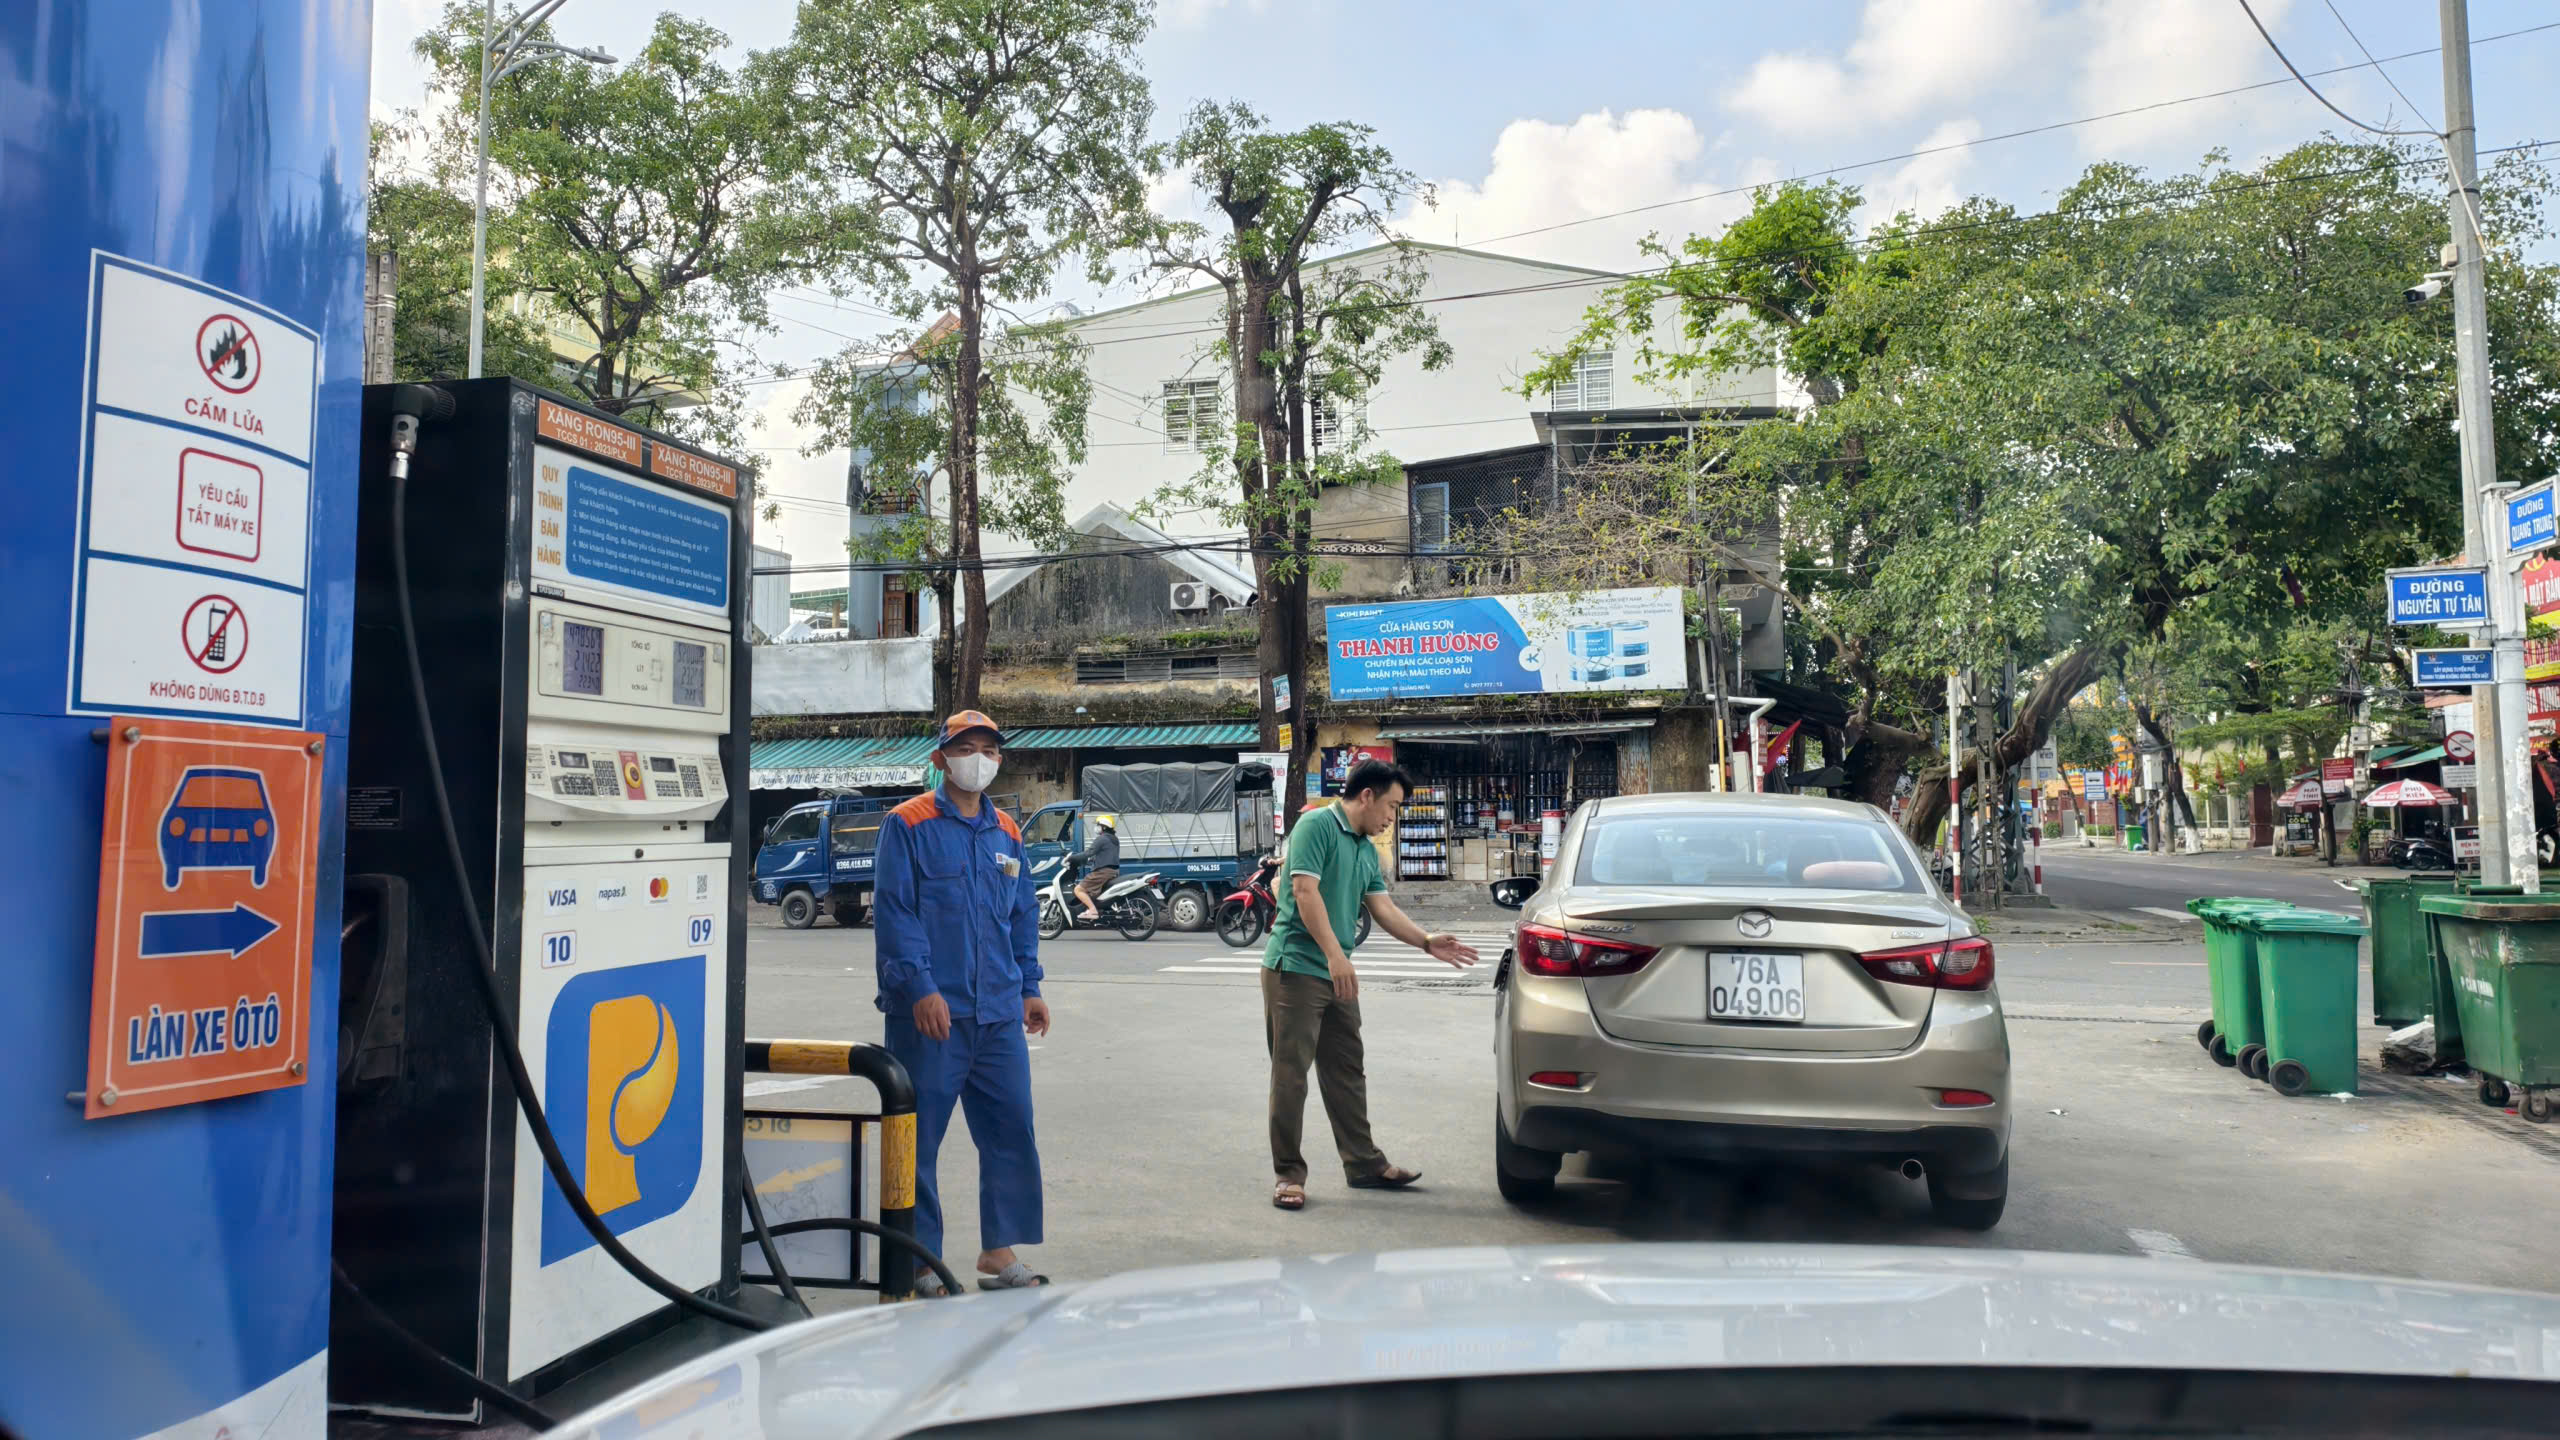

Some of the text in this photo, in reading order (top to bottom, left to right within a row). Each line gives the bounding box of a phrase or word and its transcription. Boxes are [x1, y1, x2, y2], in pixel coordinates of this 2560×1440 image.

[184, 399, 264, 437] CẤM LỬA
[547, 407, 582, 432] XĂNG
[556, 428, 577, 443] TCCS
[580, 437, 587, 448] 01
[542, 465, 559, 483] QUY
[199, 483, 248, 510] YÊU CẦU
[538, 490, 563, 512] TRÌNH
[2517, 498, 2544, 519] ĐƯỜNG
[187, 506, 254, 536] TẮT MÁY XE
[541, 517, 558, 538] BÁN
[2512, 514, 2553, 542] QUANG TRUNG
[537, 544, 561, 565] HÀNG
[2411, 579, 2464, 594] ĐƯỜNG
[2398, 594, 2482, 616] NGUYỄN TỰ TÂN
[1380, 619, 1454, 633] CỬA HÀNG SƠN
[1338, 630, 1500, 658] THANH HƯƠNG
[1365, 655, 1473, 668] CHUYÊN BÁN CÁC LOẠI SƠN
[1367, 670, 1390, 680] NHẬN
[1392, 669, 1408, 677] PHA
[1409, 668, 1428, 676] MÀU
[150, 679, 195, 702] KHÔNG
[199, 680, 230, 704] DÙNG
[875, 770, 907, 782] HONDA
[549, 889, 577, 907] VISA
[598, 887, 621, 901] napas
[691, 918, 712, 943] 09
[548, 935, 571, 963] 10
[1730, 956, 1781, 985] 76A
[1713, 987, 1801, 1016] 049.06
[127, 993, 280, 1065] LÀN XE ÔTÔ
